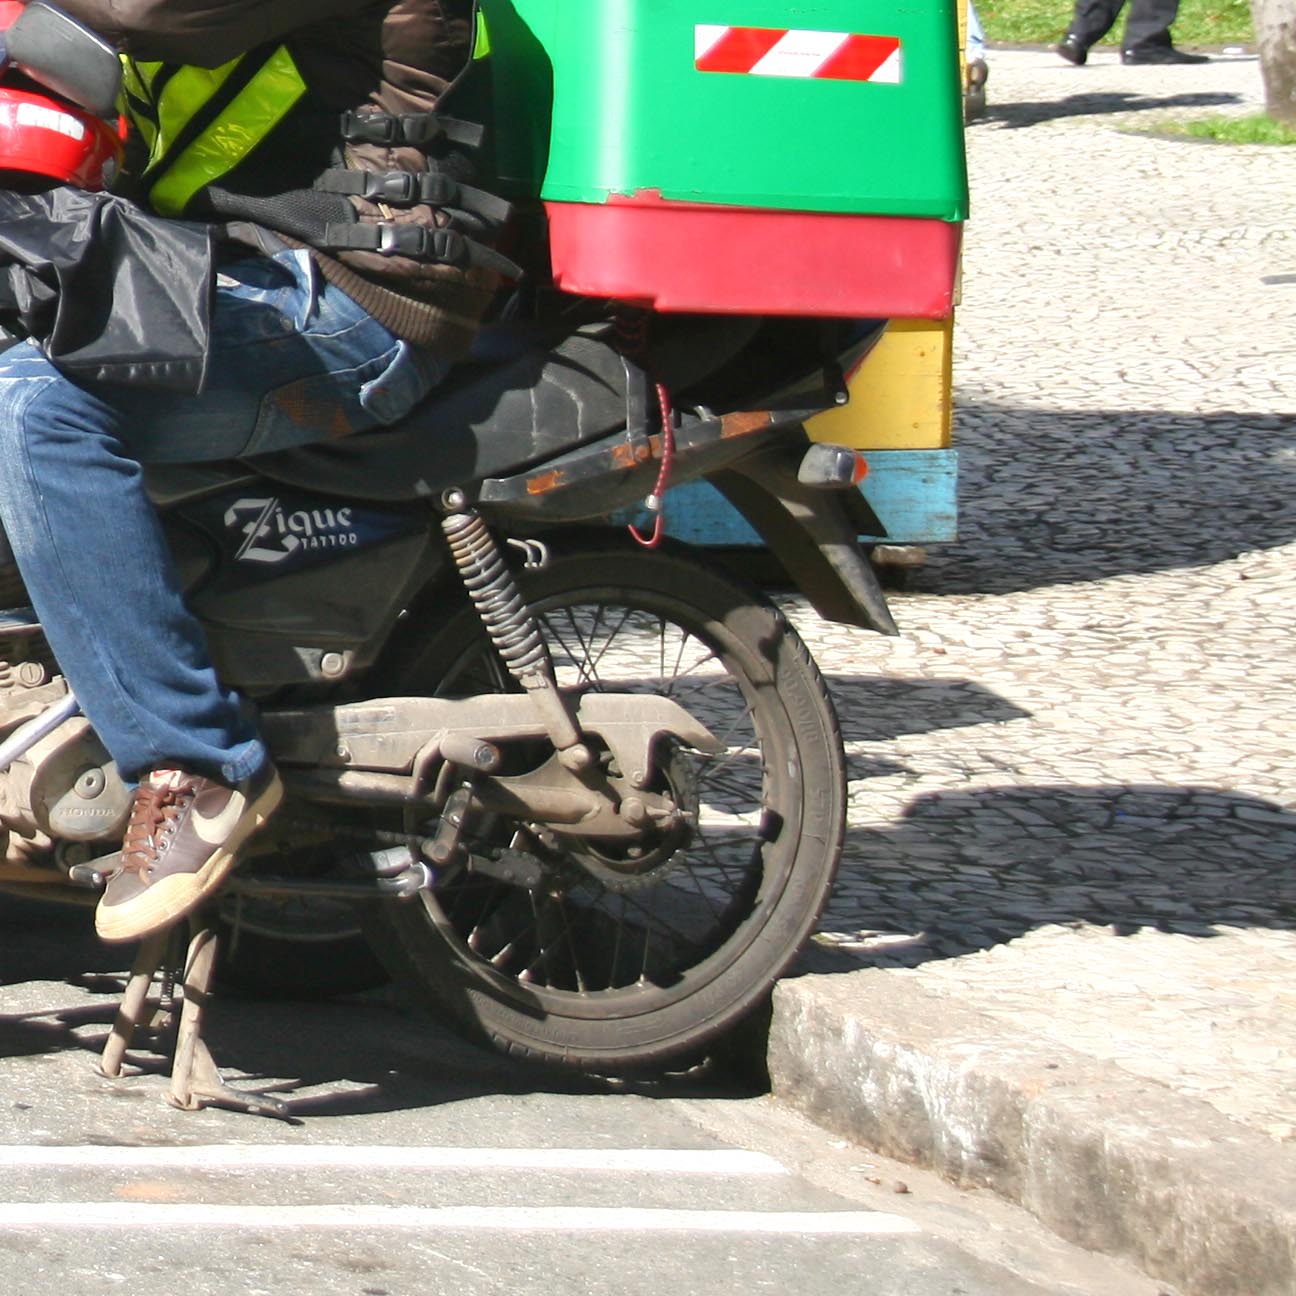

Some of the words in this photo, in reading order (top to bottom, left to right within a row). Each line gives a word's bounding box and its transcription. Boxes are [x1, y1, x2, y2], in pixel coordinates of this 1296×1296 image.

[223, 496, 352, 563] Zique
[299, 531, 358, 550] TATTOO
[59, 807, 116, 818] HONDA
